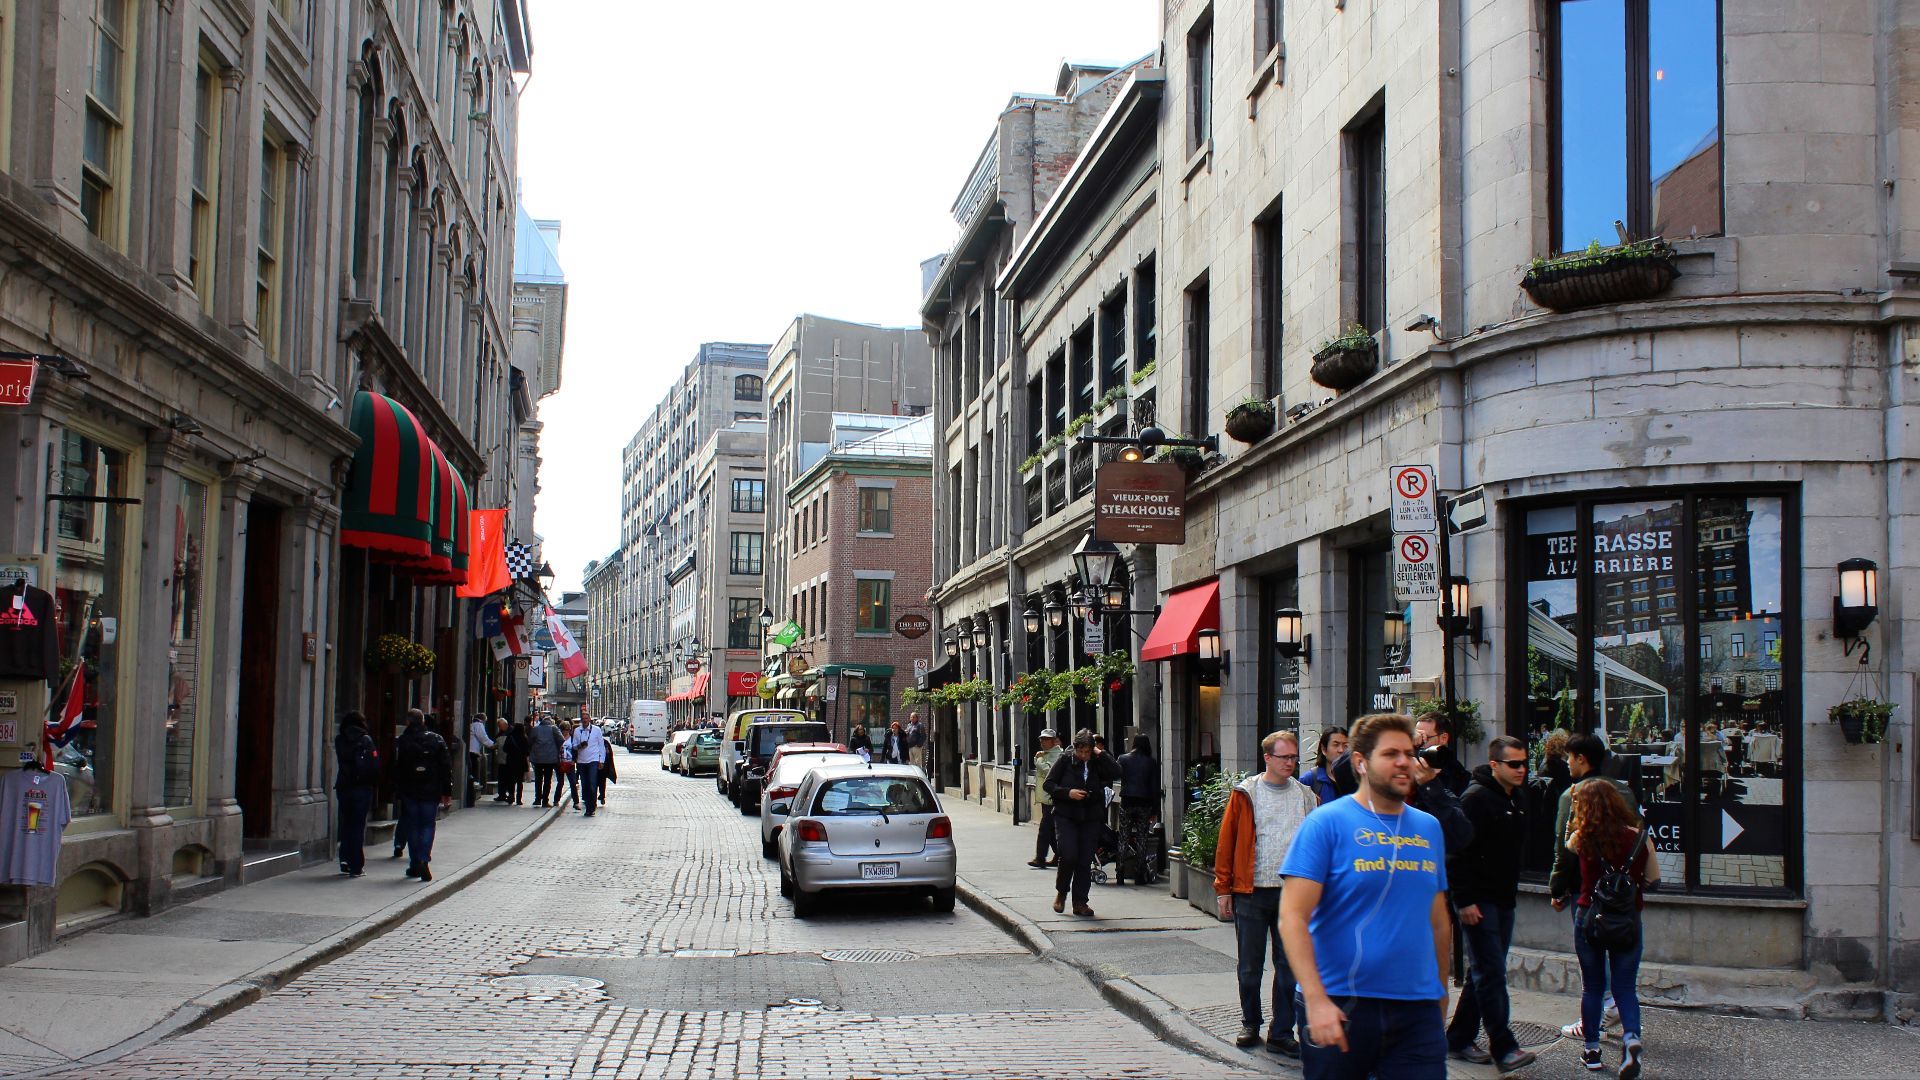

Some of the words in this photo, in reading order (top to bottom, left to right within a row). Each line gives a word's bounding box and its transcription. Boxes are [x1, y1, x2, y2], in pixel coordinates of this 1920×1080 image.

[1112, 493, 1170, 503] VIEUX-PORT
[1100, 504, 1181, 516] STEAKHOUSE
[1398, 563, 1434, 572] LIVRAISON
[1396, 572, 1436, 582] SEULEMENT
[1277, 699, 1299, 713] STEAKHO
[1373, 693, 1394, 710] STEAK
[1647, 825, 1680, 839] ACE
[1376, 832, 1430, 849] Expedia
[1656, 842, 1680, 851] ACK
[1353, 856, 1386, 873] find
[1387, 859, 1419, 874] your
